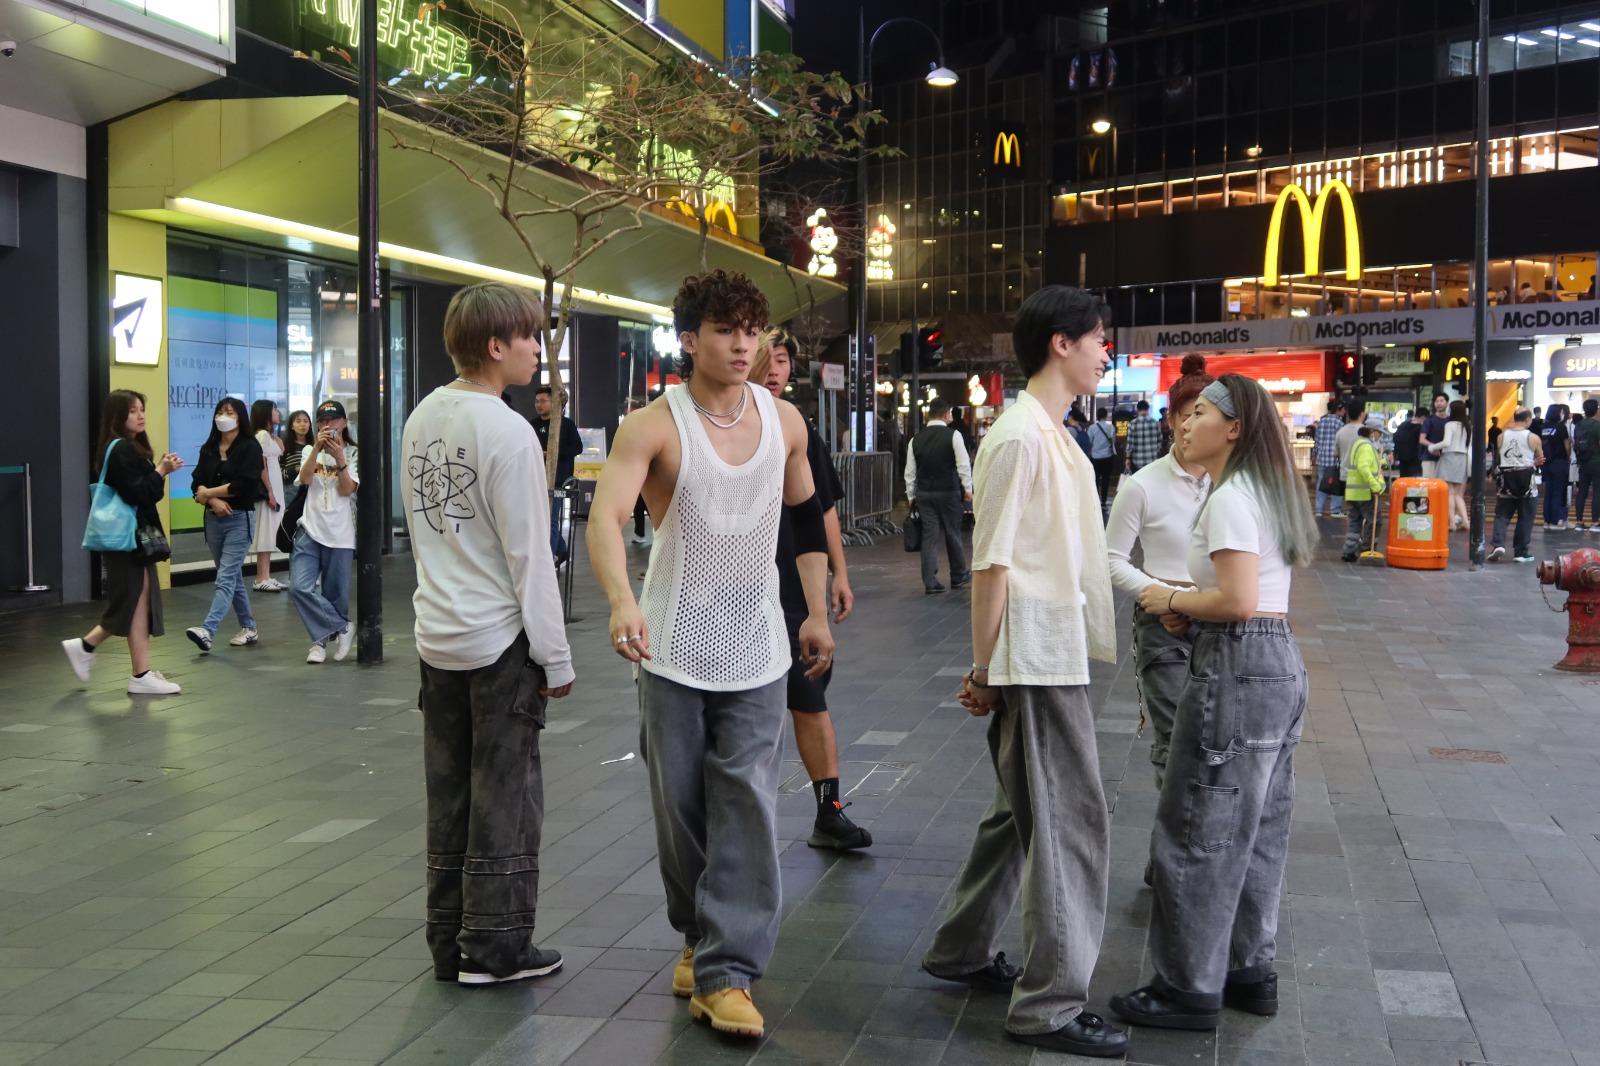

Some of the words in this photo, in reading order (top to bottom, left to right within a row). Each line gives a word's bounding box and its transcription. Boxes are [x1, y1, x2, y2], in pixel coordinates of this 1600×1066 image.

[1315, 317, 1425, 339] McDonald's
[1502, 307, 1600, 329] McDonal
[1156, 327, 1250, 347] McDonald's
